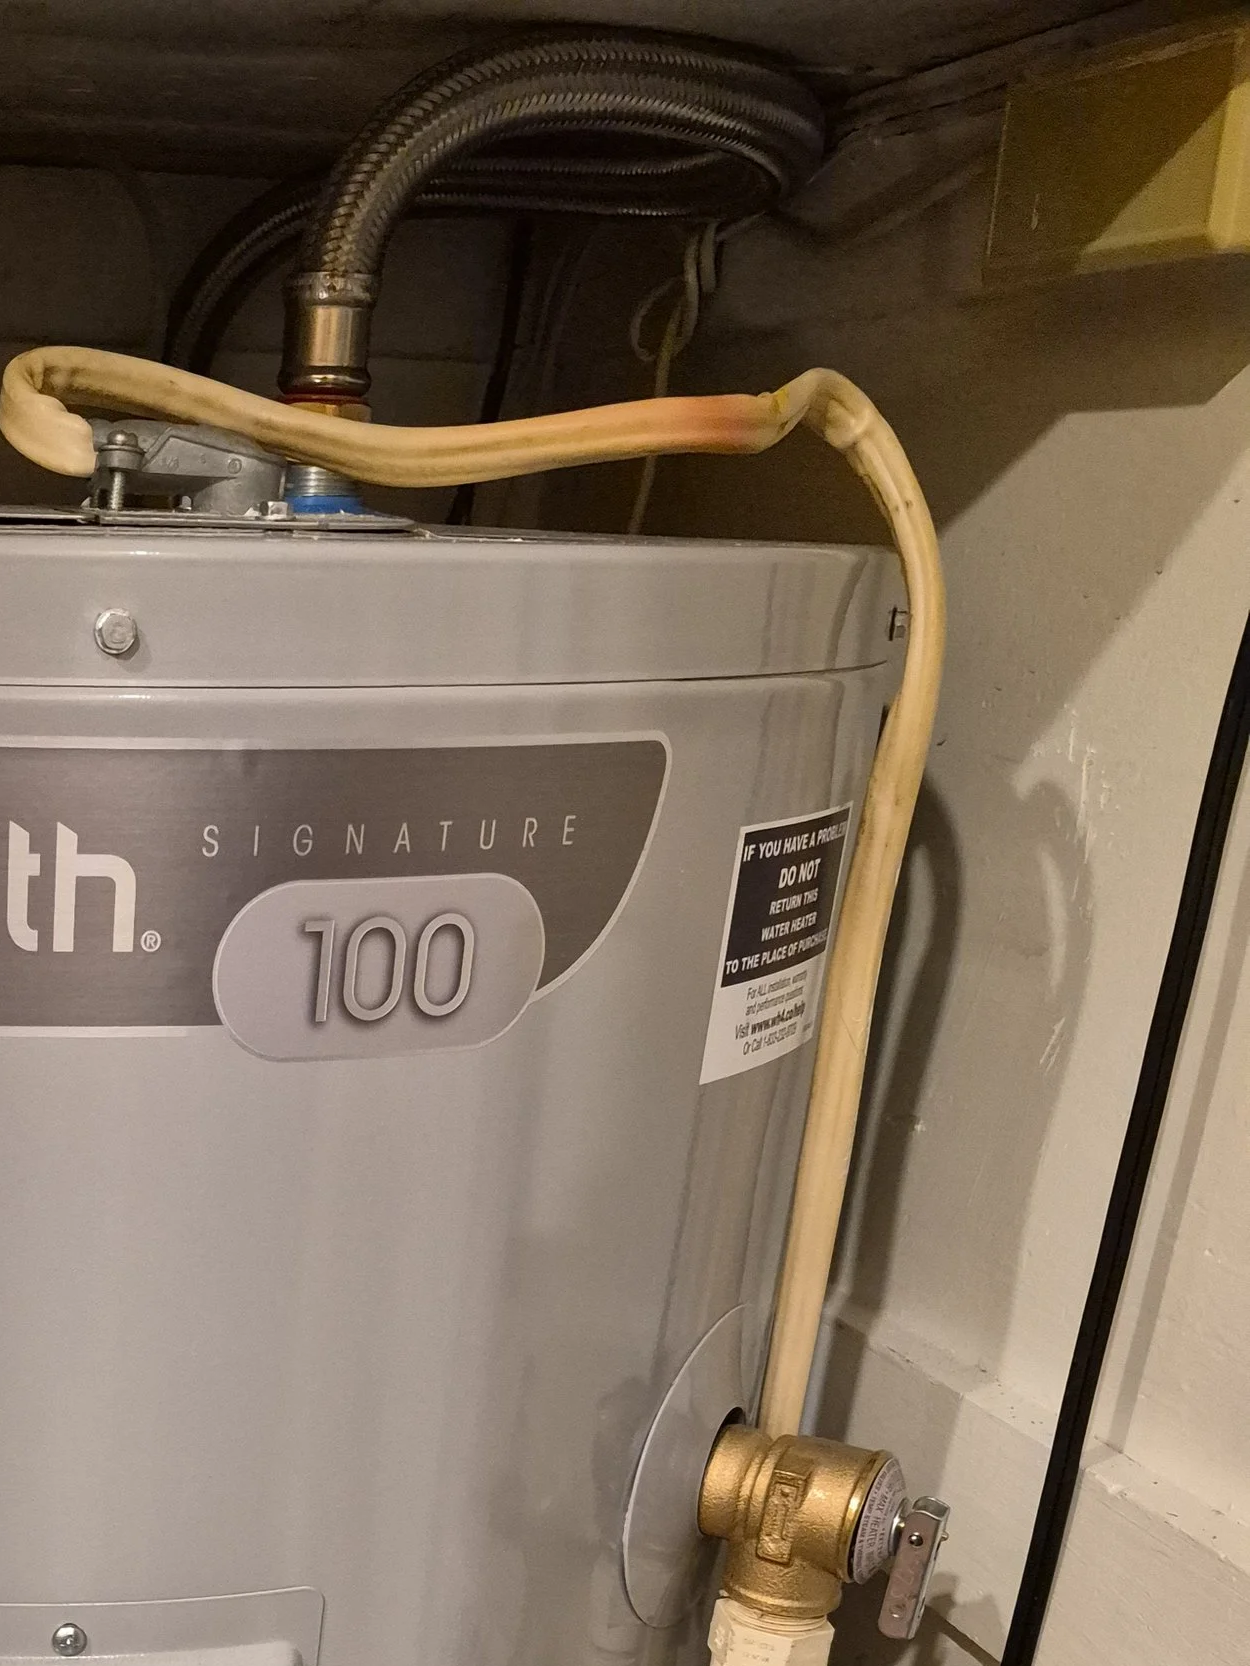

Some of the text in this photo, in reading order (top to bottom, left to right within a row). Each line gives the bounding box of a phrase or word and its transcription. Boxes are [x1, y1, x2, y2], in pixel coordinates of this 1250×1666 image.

[202, 815, 579, 858] SIGNATURE
[743, 844, 756, 862] IF
[759, 840, 782, 859] YOU
[783, 833, 808, 855] HAVE
[809, 832, 815, 848] A
[778, 858, 821, 889] DO NOT
[769, 888, 819, 915] RETURN THIS
[761, 912, 817, 942] WATER HEATER
[725, 928, 828, 975] TO THE PLACE OF PURCHASE
[304, 913, 475, 1023] 100
